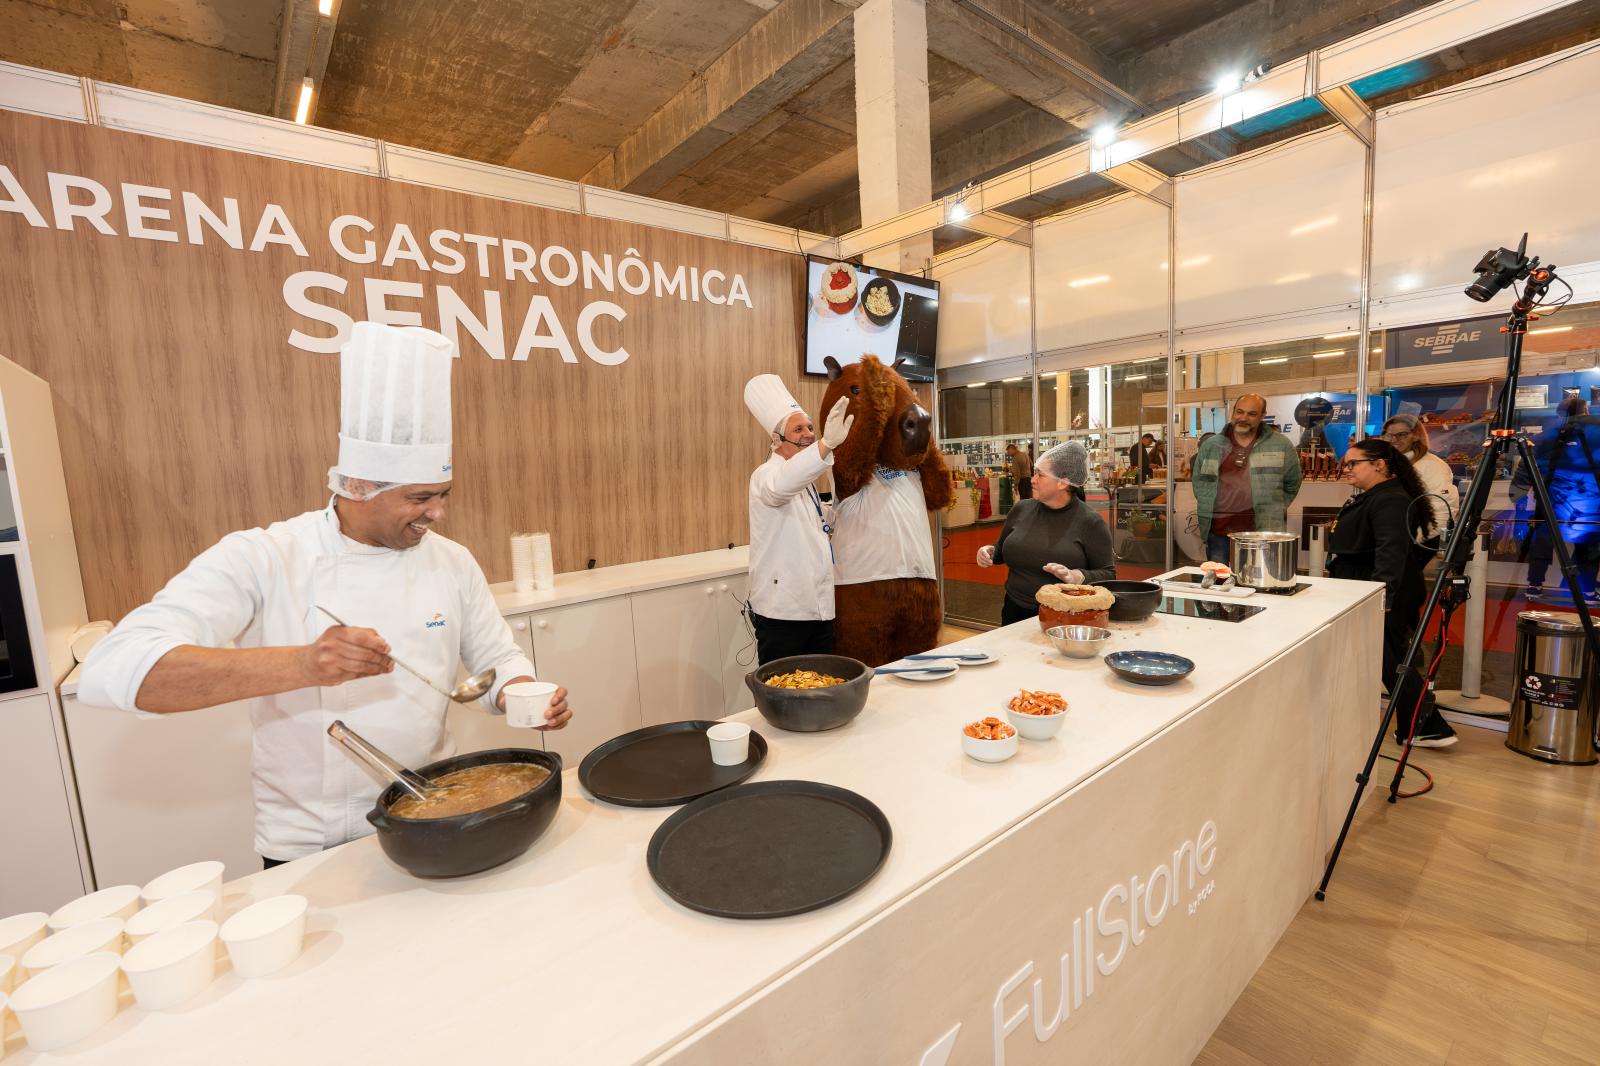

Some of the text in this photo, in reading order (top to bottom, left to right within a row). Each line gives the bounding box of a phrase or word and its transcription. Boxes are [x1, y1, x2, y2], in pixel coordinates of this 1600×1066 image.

[0, 165, 754, 309] ARENA GASTRONÔMICA
[1413, 330, 1482, 348] SEBRAE
[992, 819, 1218, 1066] FullStone
